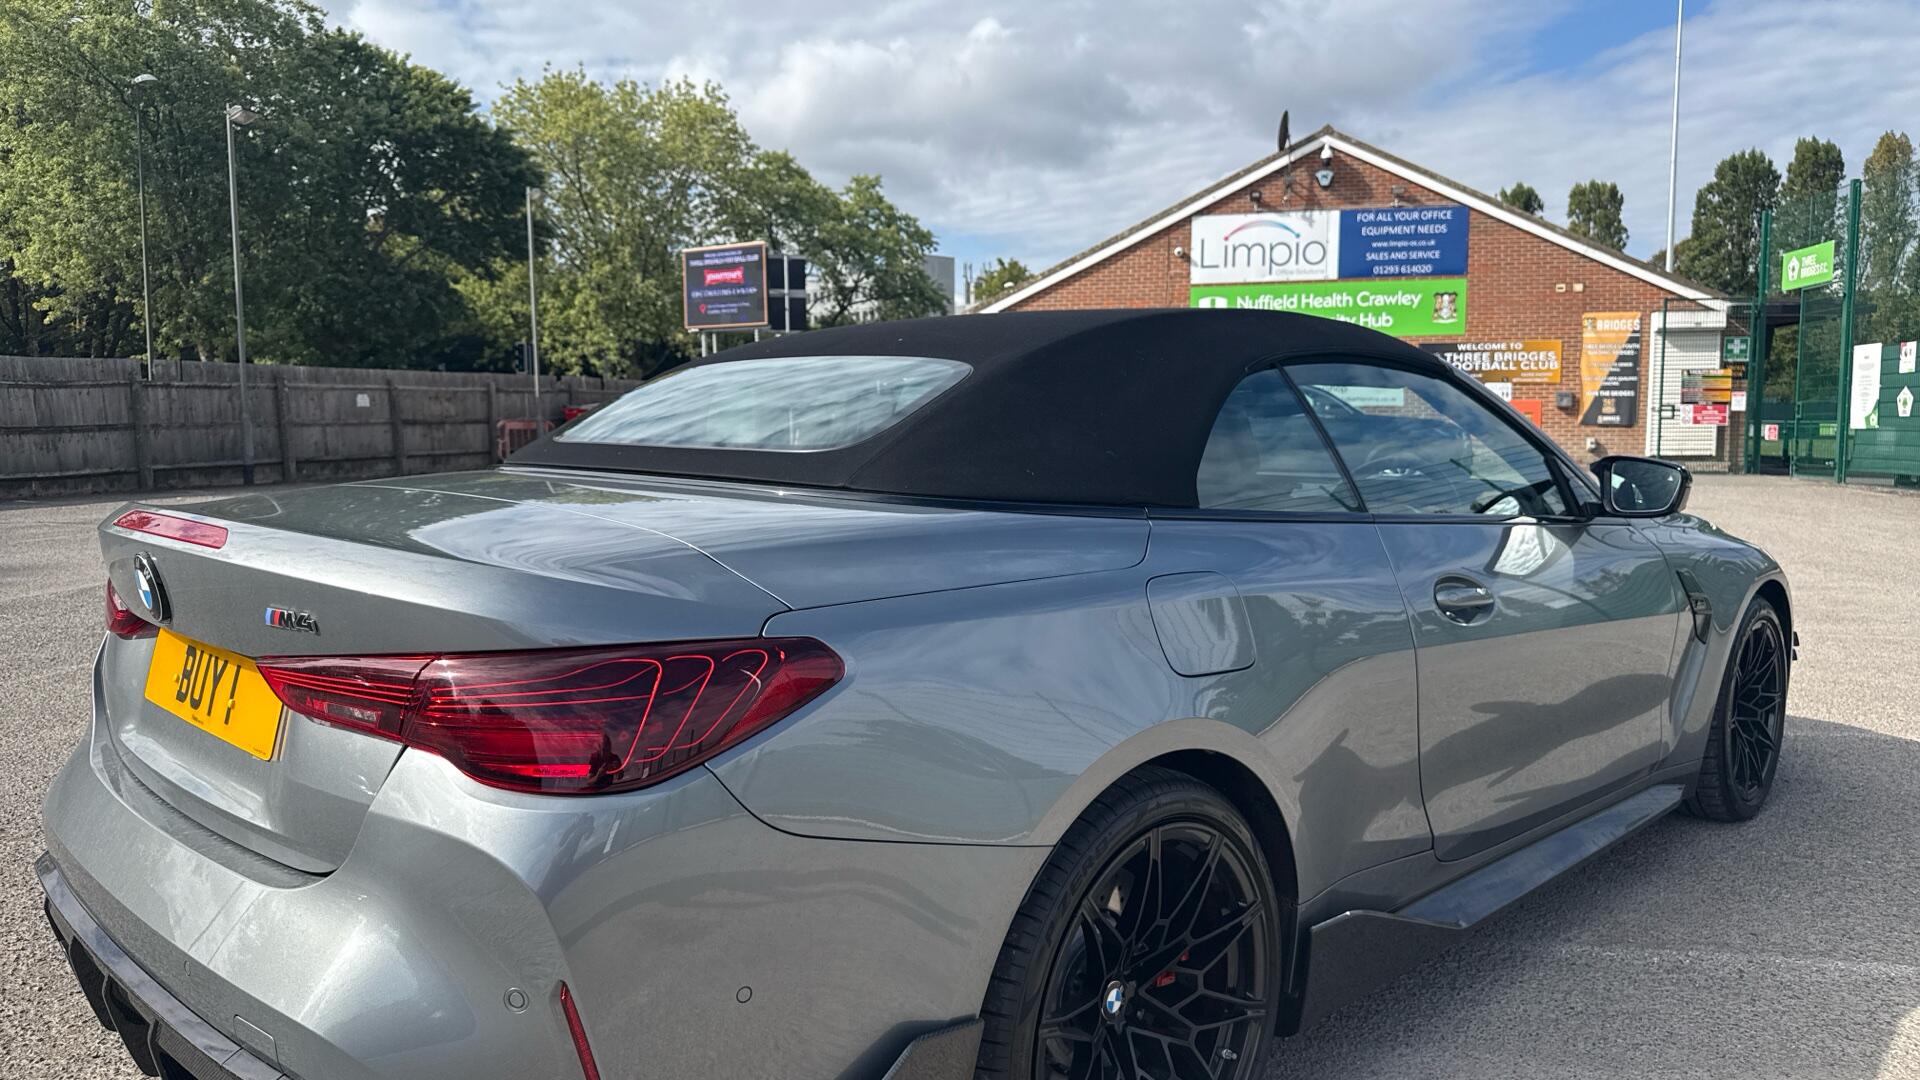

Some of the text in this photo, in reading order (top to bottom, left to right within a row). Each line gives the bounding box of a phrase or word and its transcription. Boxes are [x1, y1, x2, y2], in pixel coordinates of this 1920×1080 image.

[1357, 210, 1453, 222] FOR ALL YOUR OFFICE
[1361, 224, 1448, 236] EQUIPMENT NEEDS
[1201, 236, 1327, 275] Limpio
[1366, 250, 1441, 261] SALES AND SERVICE
[1373, 264, 1433, 275] 01293 614020
[1237, 290, 1423, 309] Nuffield Health Crawley
[1359, 312, 1393, 328] Hub
[1597, 319, 1640, 331] BRIDGES
[1457, 342, 1523, 351] WELCOME TO
[1444, 351, 1556, 362] THREE BRIDGES
[1450, 360, 1560, 371] OOTBALL CLUB
[176, 645, 229, 717] BUY
